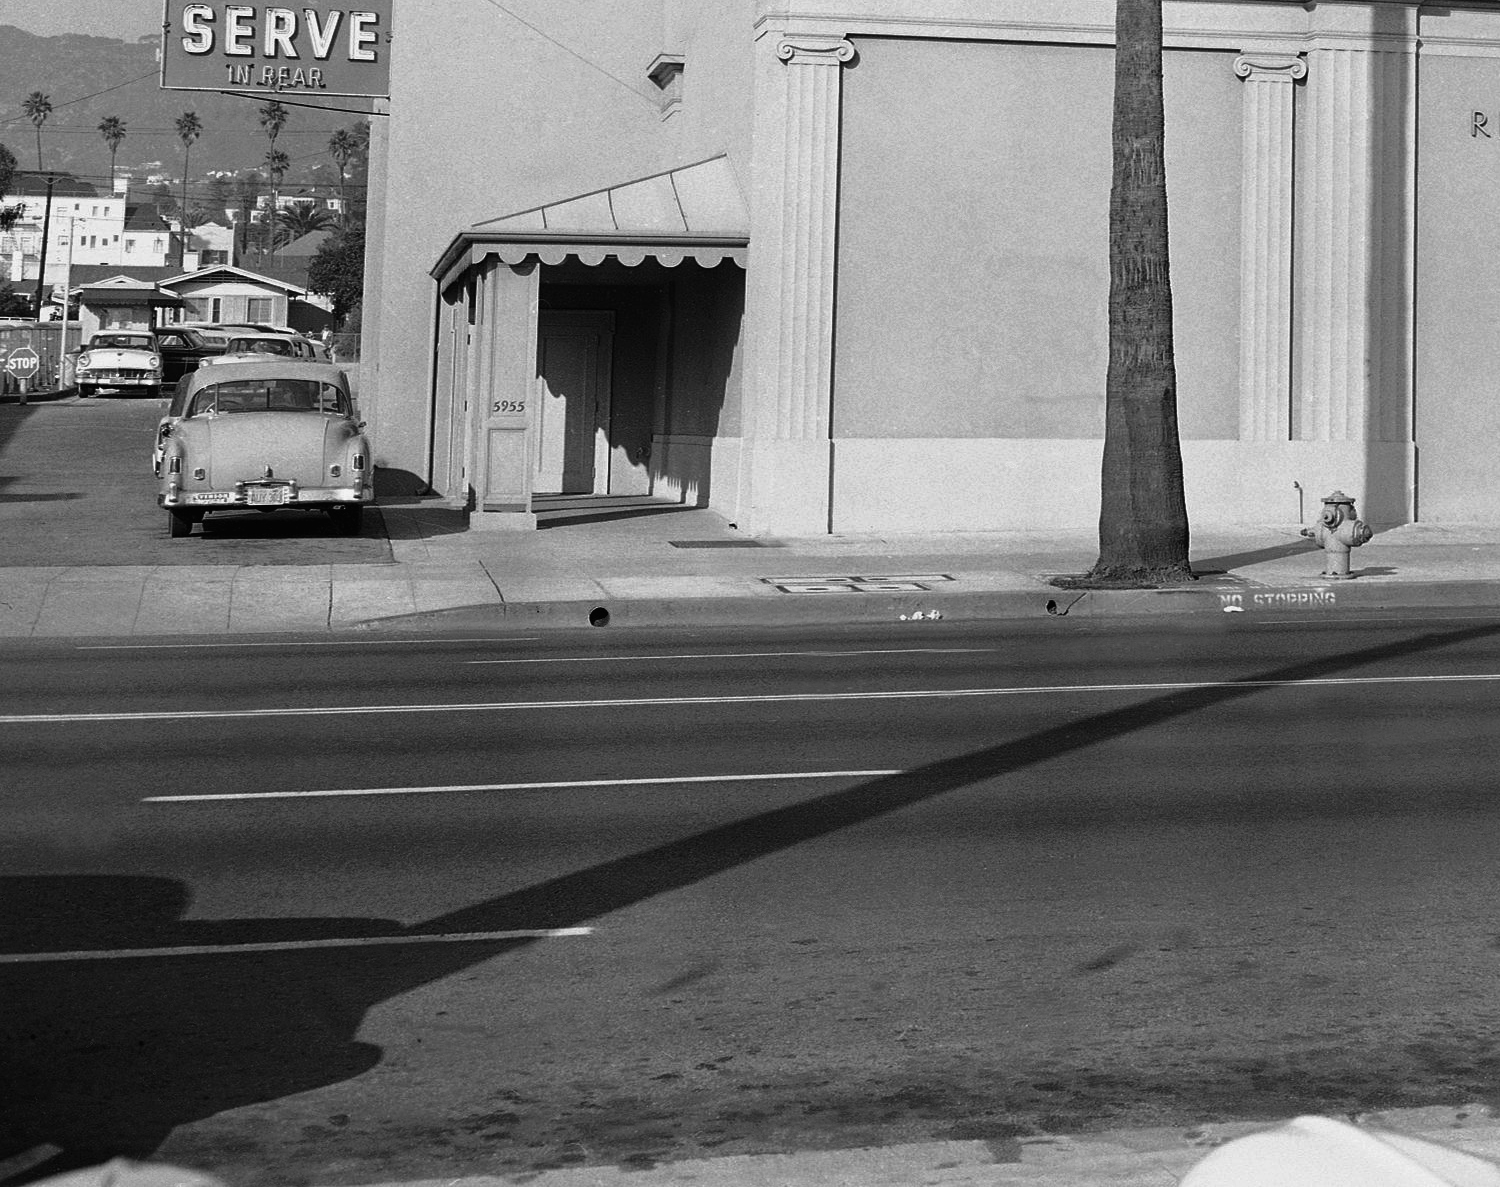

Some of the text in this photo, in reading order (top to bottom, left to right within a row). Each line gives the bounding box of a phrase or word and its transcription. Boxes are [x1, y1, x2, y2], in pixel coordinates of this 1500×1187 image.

[182, 3, 379, 62] SERVE
[226, 64, 325, 89] IN REAR
[9, 357, 37, 370] STOP
[492, 399, 526, 413] 5955
[1218, 592, 1337, 607] NO STOPPING
